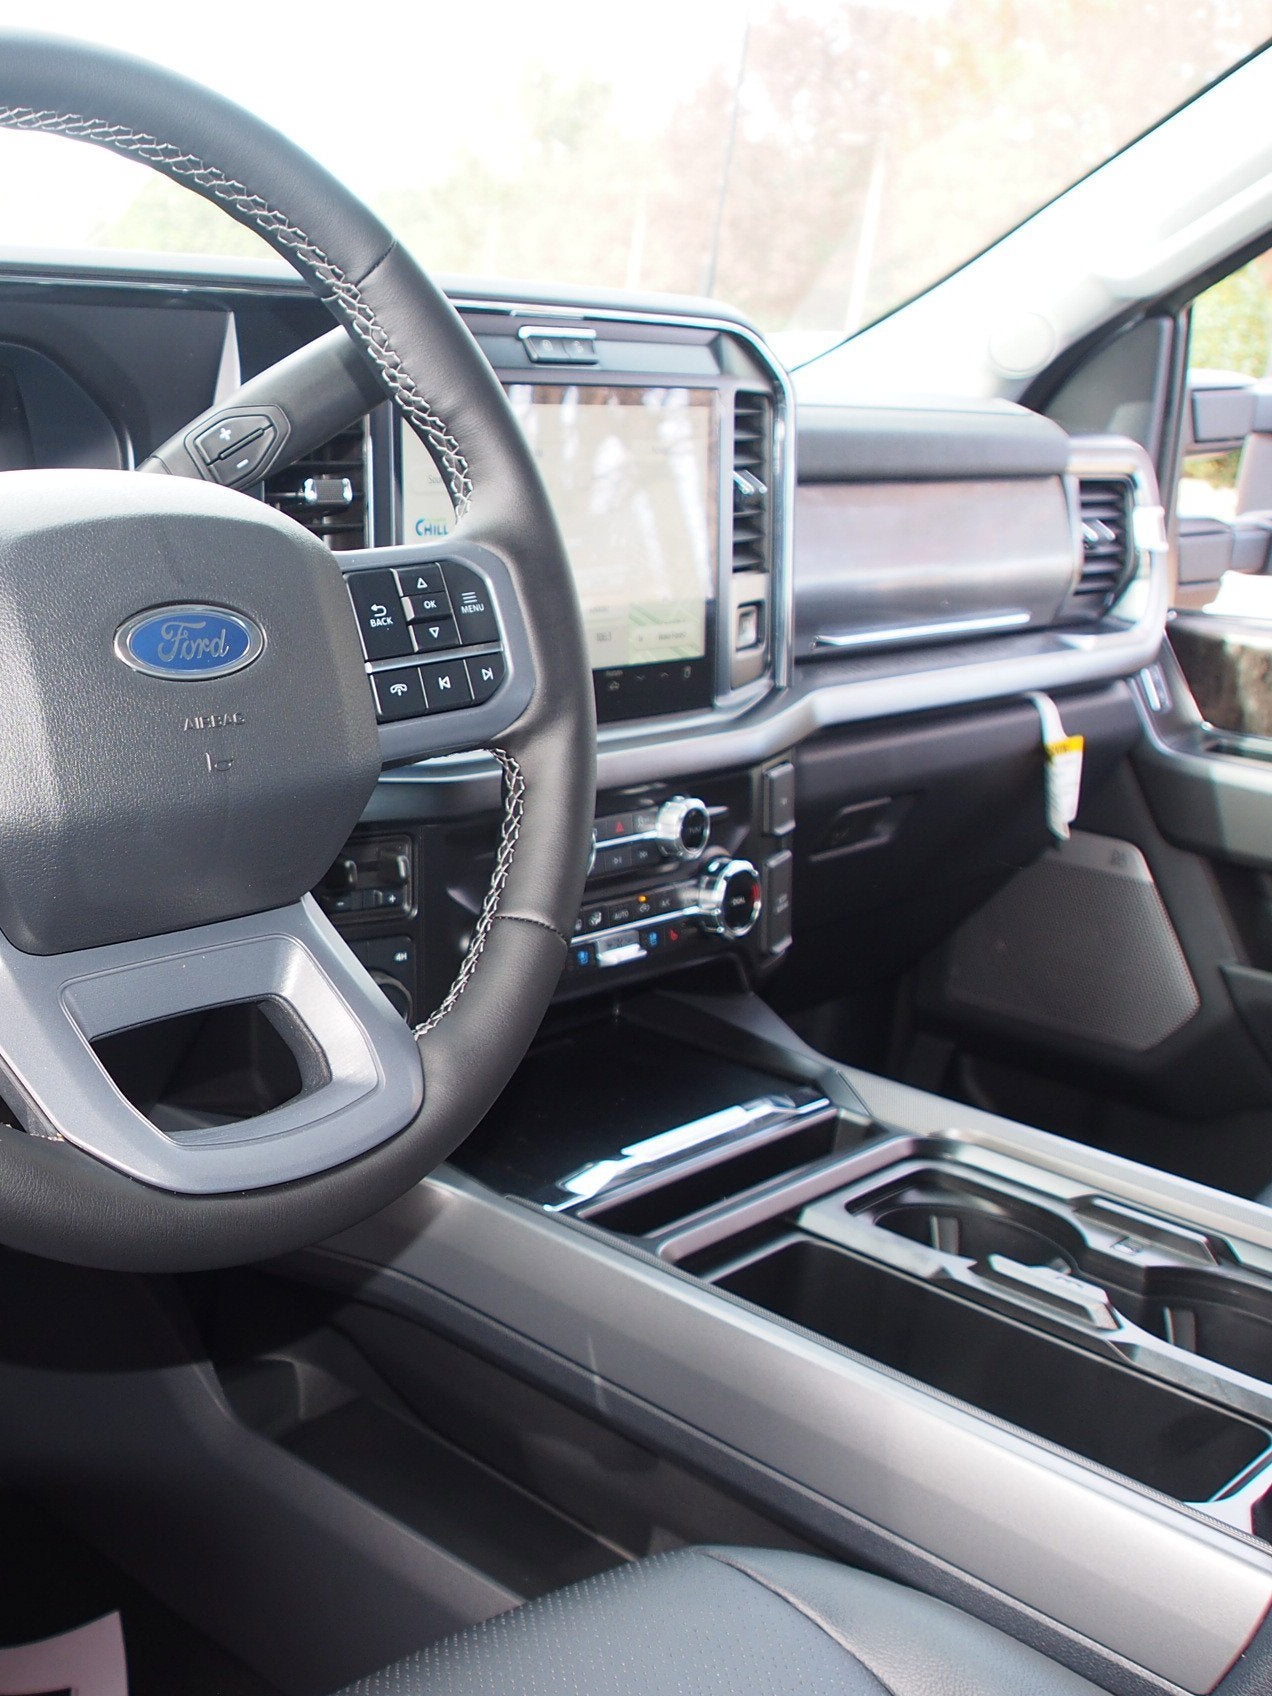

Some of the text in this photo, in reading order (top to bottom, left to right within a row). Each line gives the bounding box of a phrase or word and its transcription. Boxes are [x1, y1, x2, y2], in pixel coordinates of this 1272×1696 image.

[415, 517, 449, 536] CHILL
[423, 600, 437, 609] OK
[461, 603, 485, 614] MENU
[369, 616, 394, 628] BACK
[157, 621, 230, 662] Ford
[183, 712, 246, 731] AIRBAG
[394, 951, 408, 962] 4H
